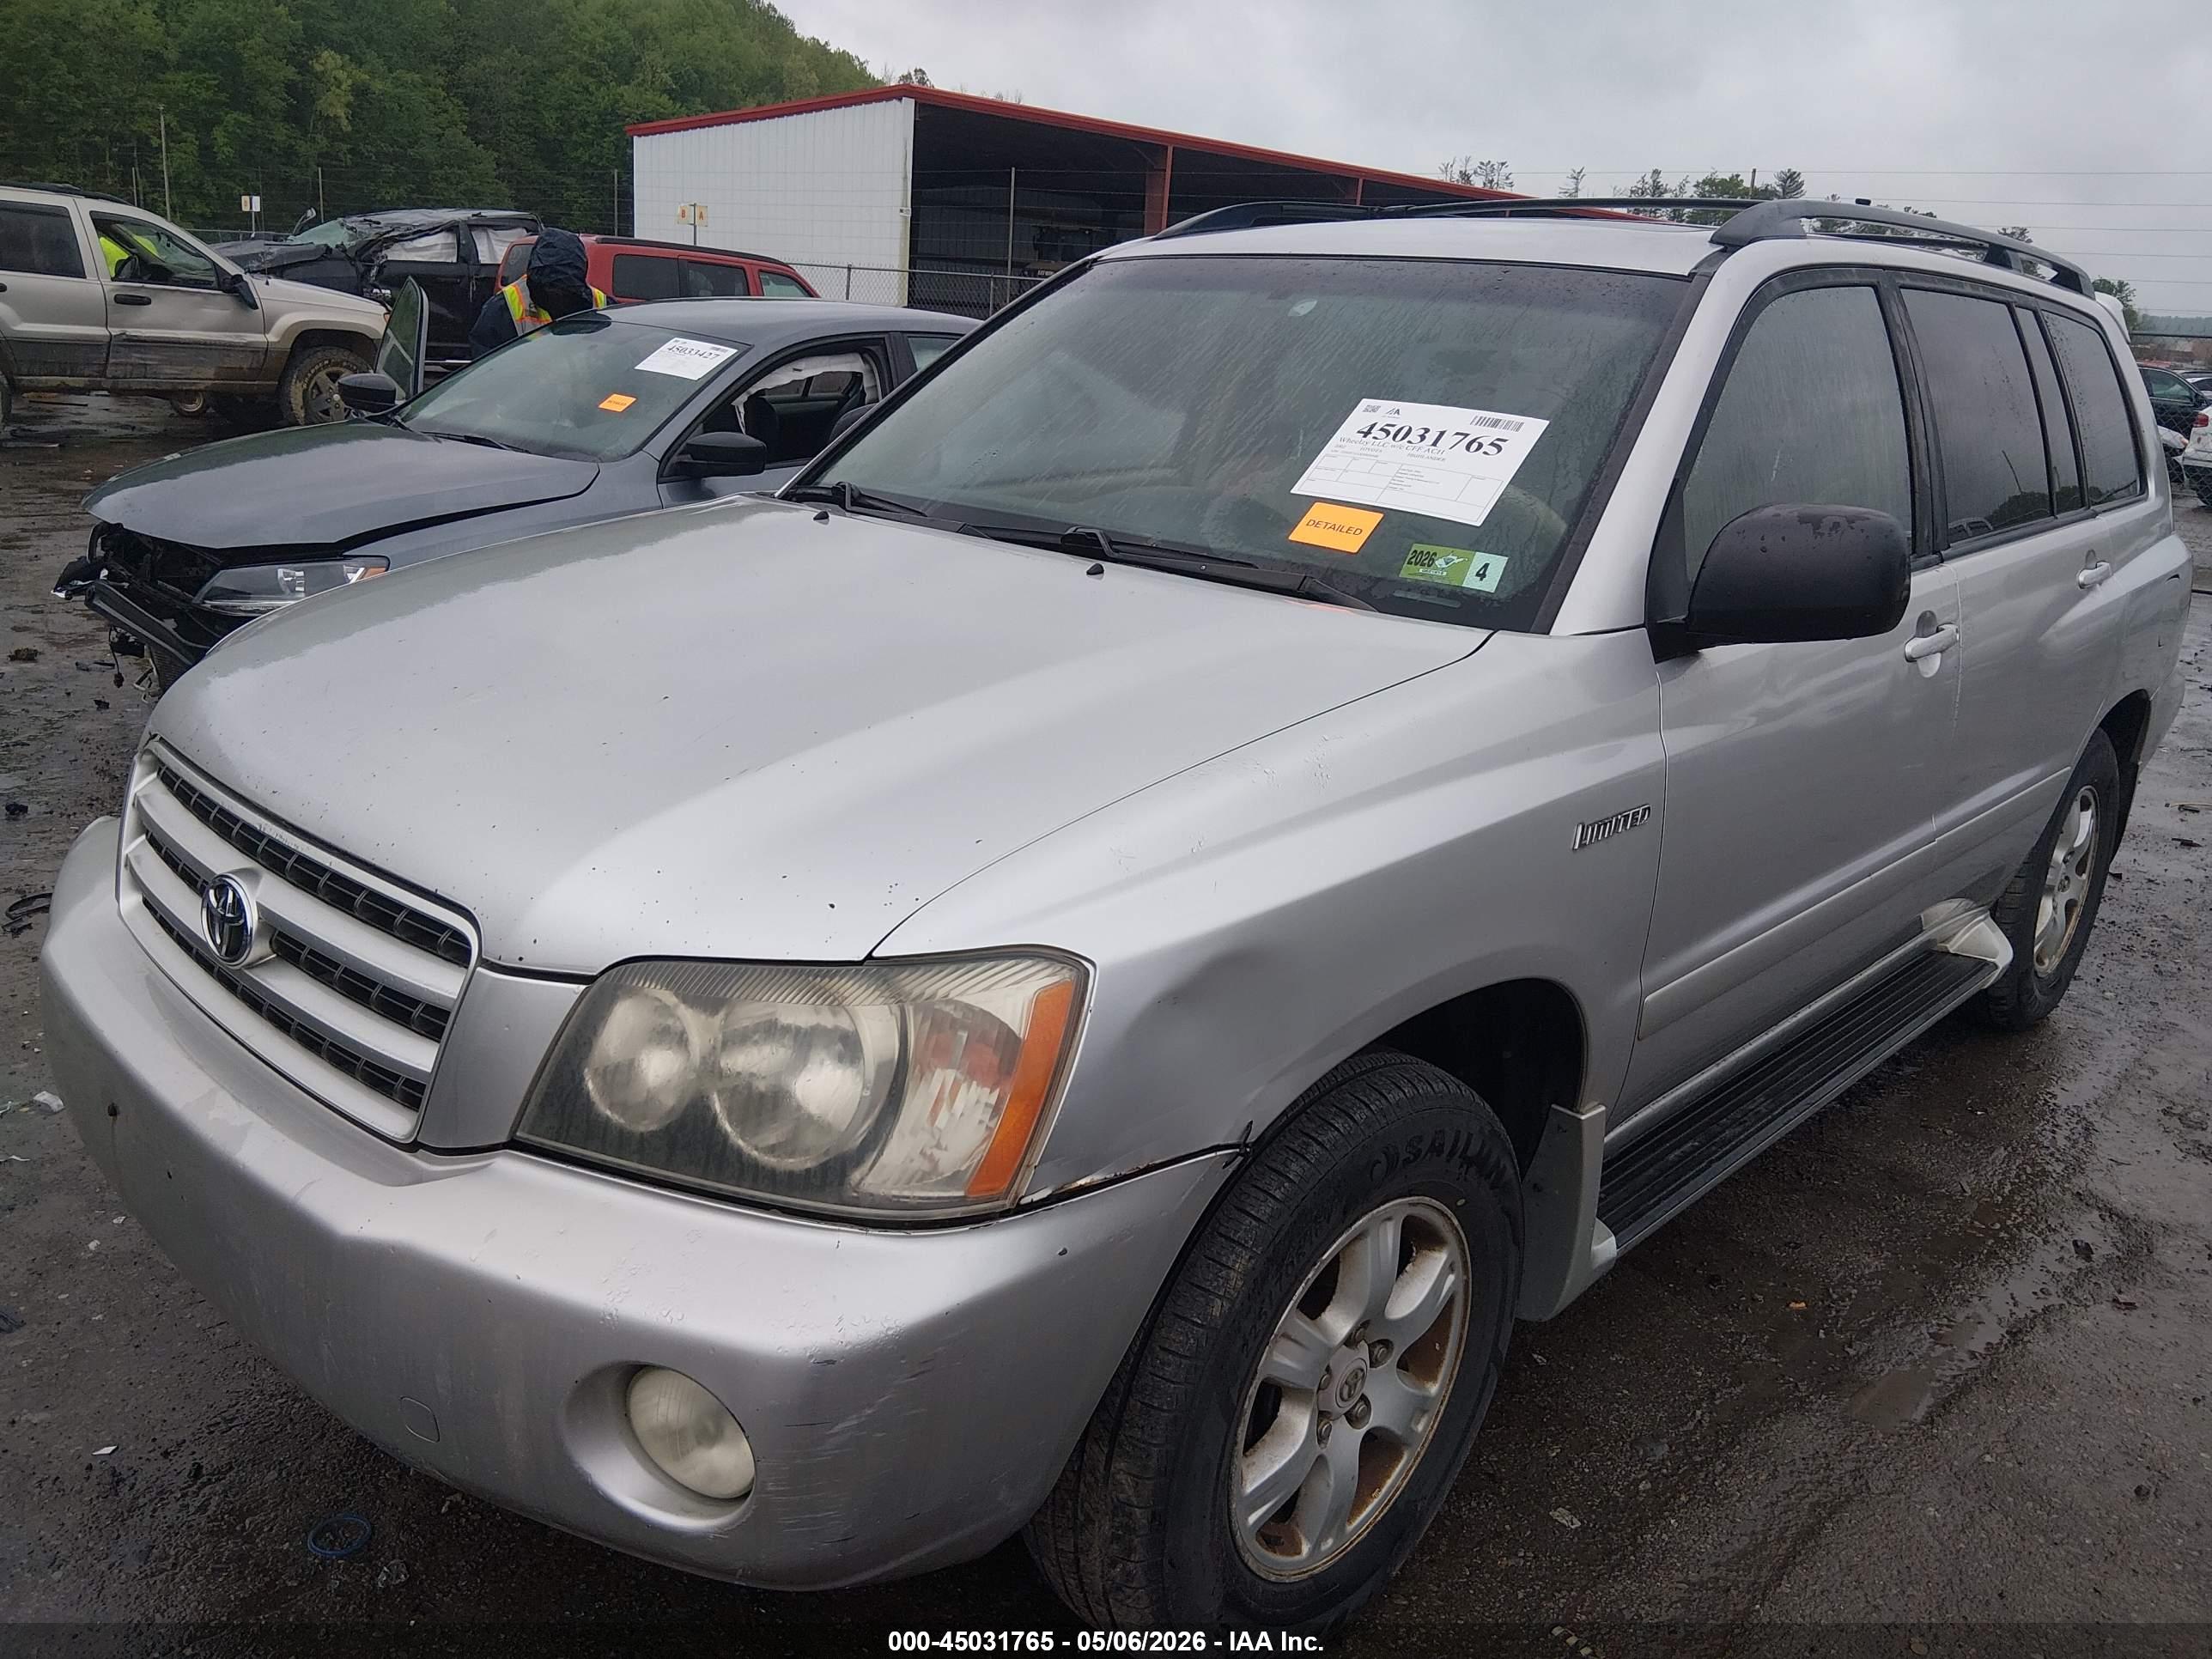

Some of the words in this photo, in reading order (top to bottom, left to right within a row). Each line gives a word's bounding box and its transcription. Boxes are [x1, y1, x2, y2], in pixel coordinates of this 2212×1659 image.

[1357, 422, 1510, 456] 45031765
[1306, 519, 1364, 536] DETAILED
[1407, 550, 1437, 568] 2026
[1475, 562, 1490, 581] 4
[1572, 804, 1650, 850] LIMITED
